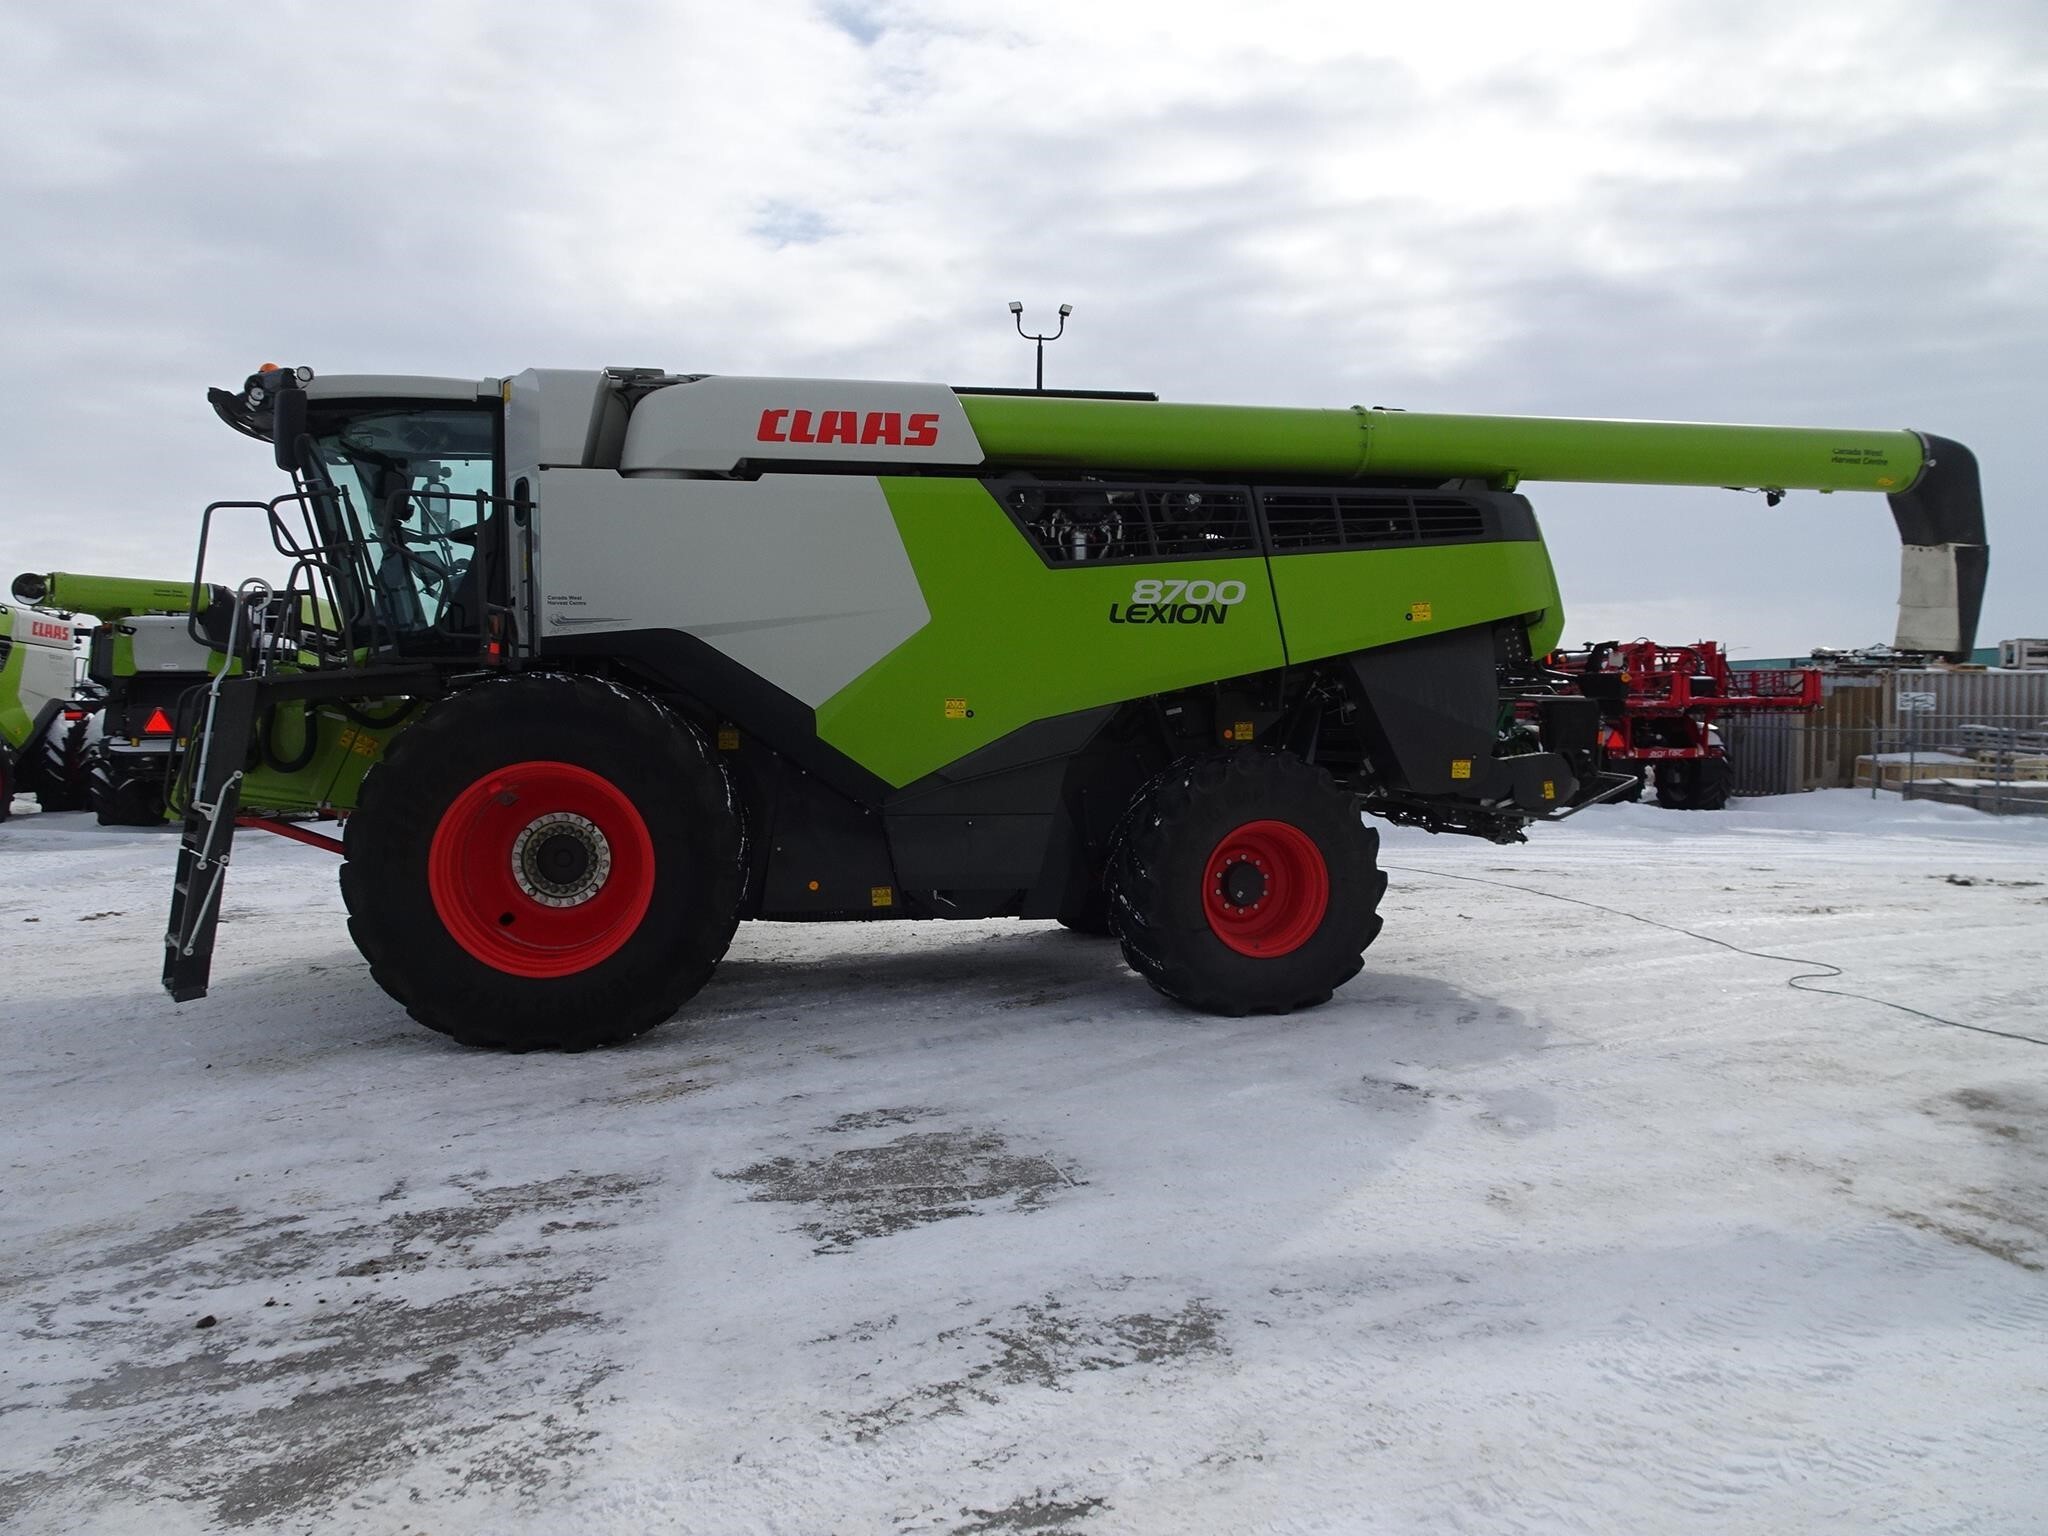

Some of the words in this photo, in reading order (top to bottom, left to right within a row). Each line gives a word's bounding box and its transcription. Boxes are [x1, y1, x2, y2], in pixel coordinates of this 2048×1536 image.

[757, 409, 940, 446] CLAAS
[1131, 579, 1247, 605] 8700
[1109, 603, 1229, 625] LEXION
[32, 621, 69, 640] CLAAS
